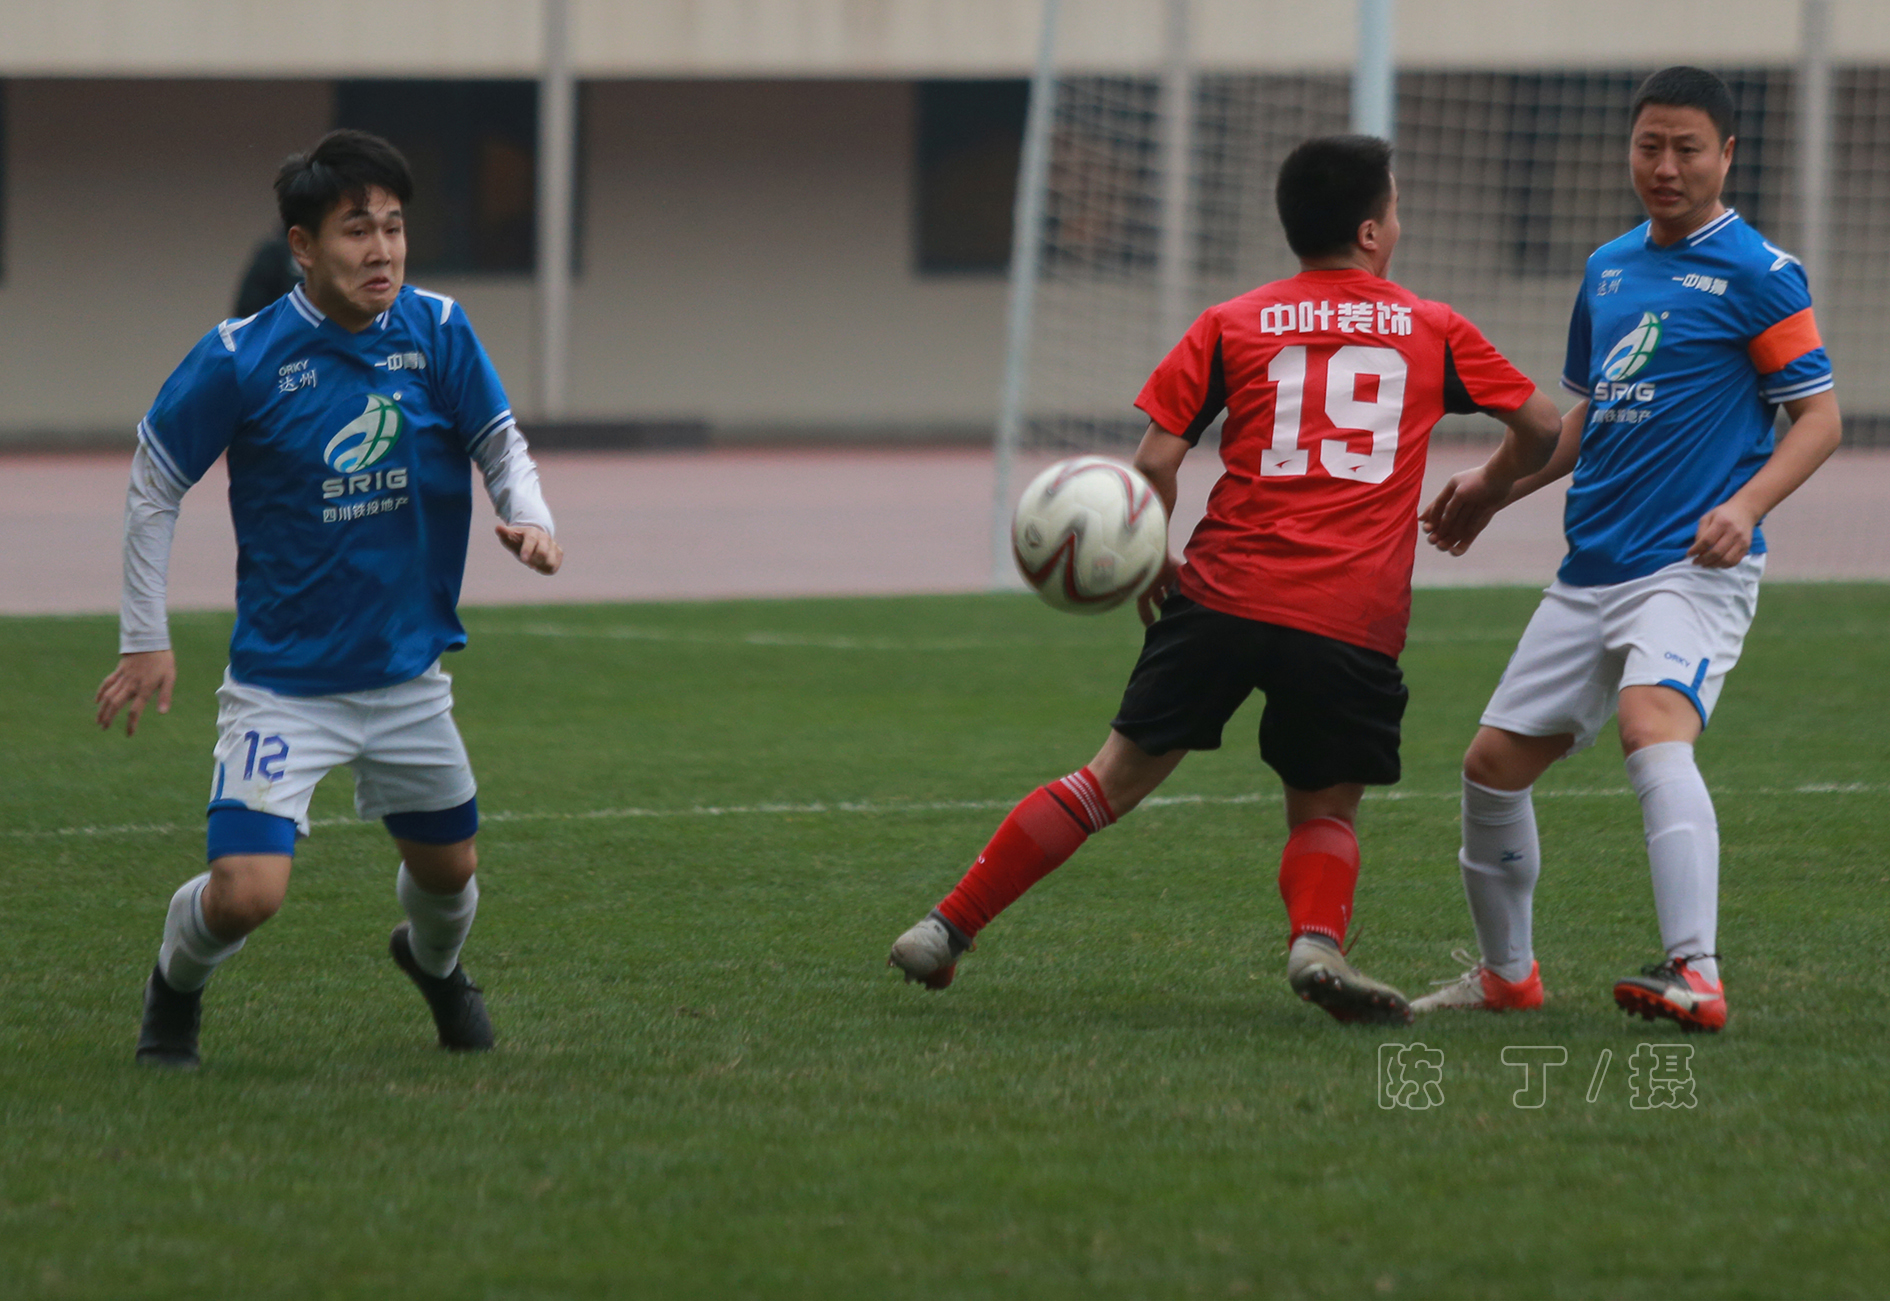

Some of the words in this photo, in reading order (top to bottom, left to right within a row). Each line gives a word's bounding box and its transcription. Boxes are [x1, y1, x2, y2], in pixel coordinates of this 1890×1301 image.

[1260, 300, 1413, 336] 中叶装饰
[278, 358, 310, 377] ORKY
[278, 369, 318, 394] 达州
[1260, 345, 1408, 485] 19
[322, 467, 408, 499] SRIG
[322, 496, 409, 524] 四川铁投地产
[242, 729, 290, 783] 12
